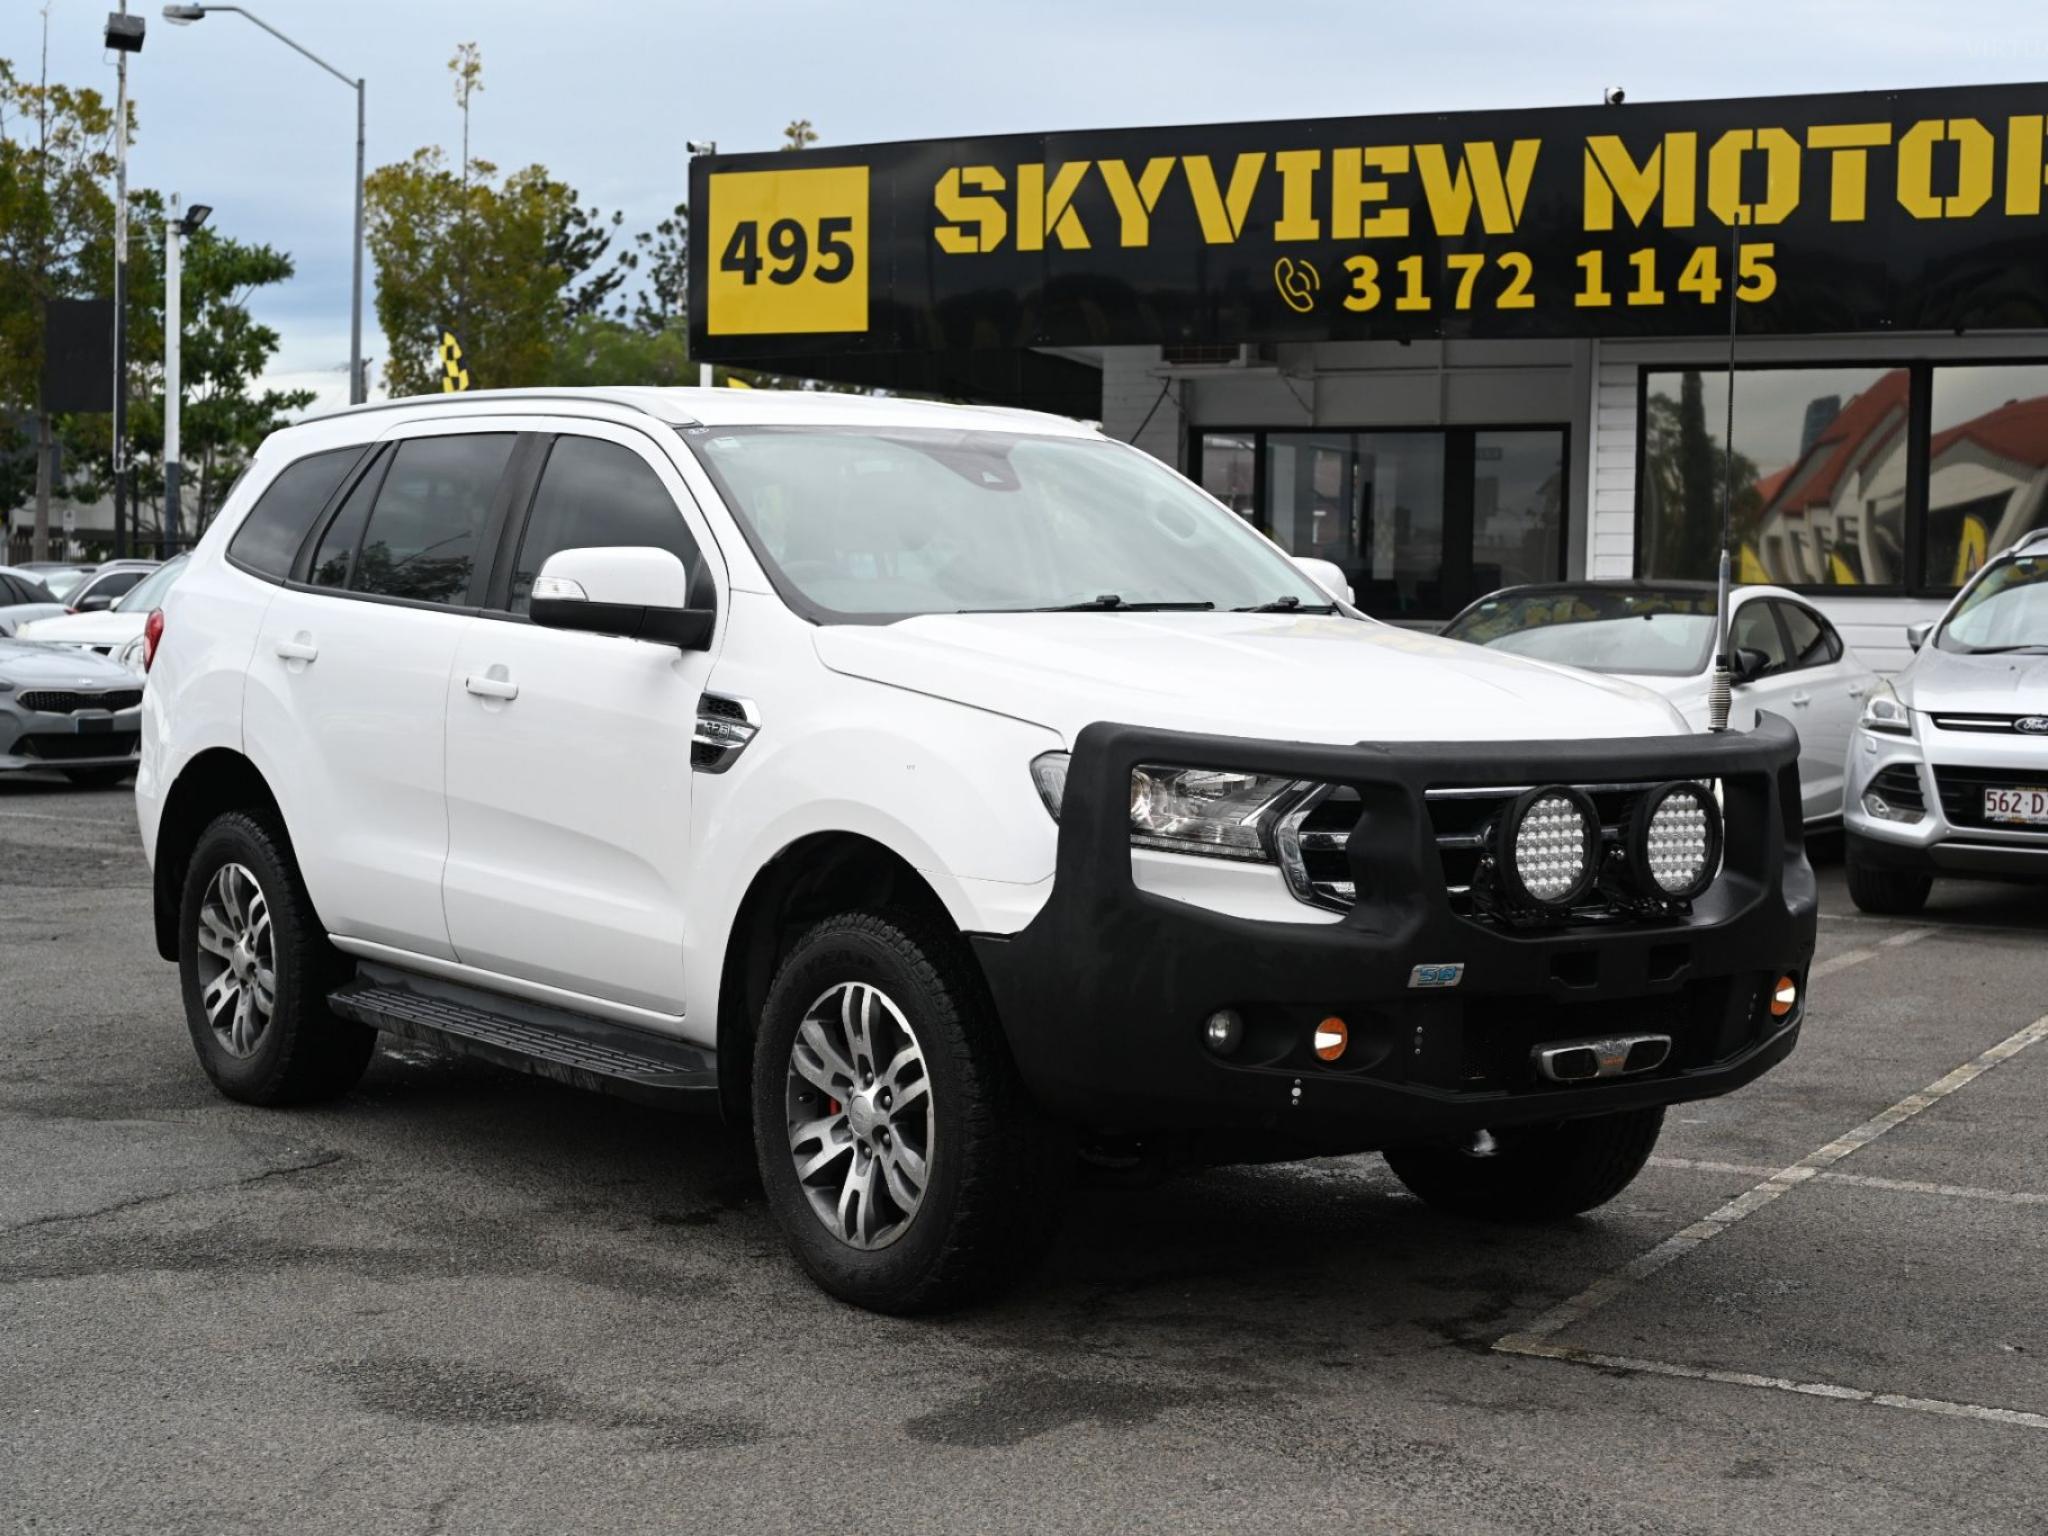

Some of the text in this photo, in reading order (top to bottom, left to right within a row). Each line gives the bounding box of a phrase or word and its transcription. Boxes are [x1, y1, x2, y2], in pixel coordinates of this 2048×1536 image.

[934, 138, 1541, 253] SKYVIEW
[720, 216, 854, 286] 495
[1344, 241, 1778, 312] 3172 1145
